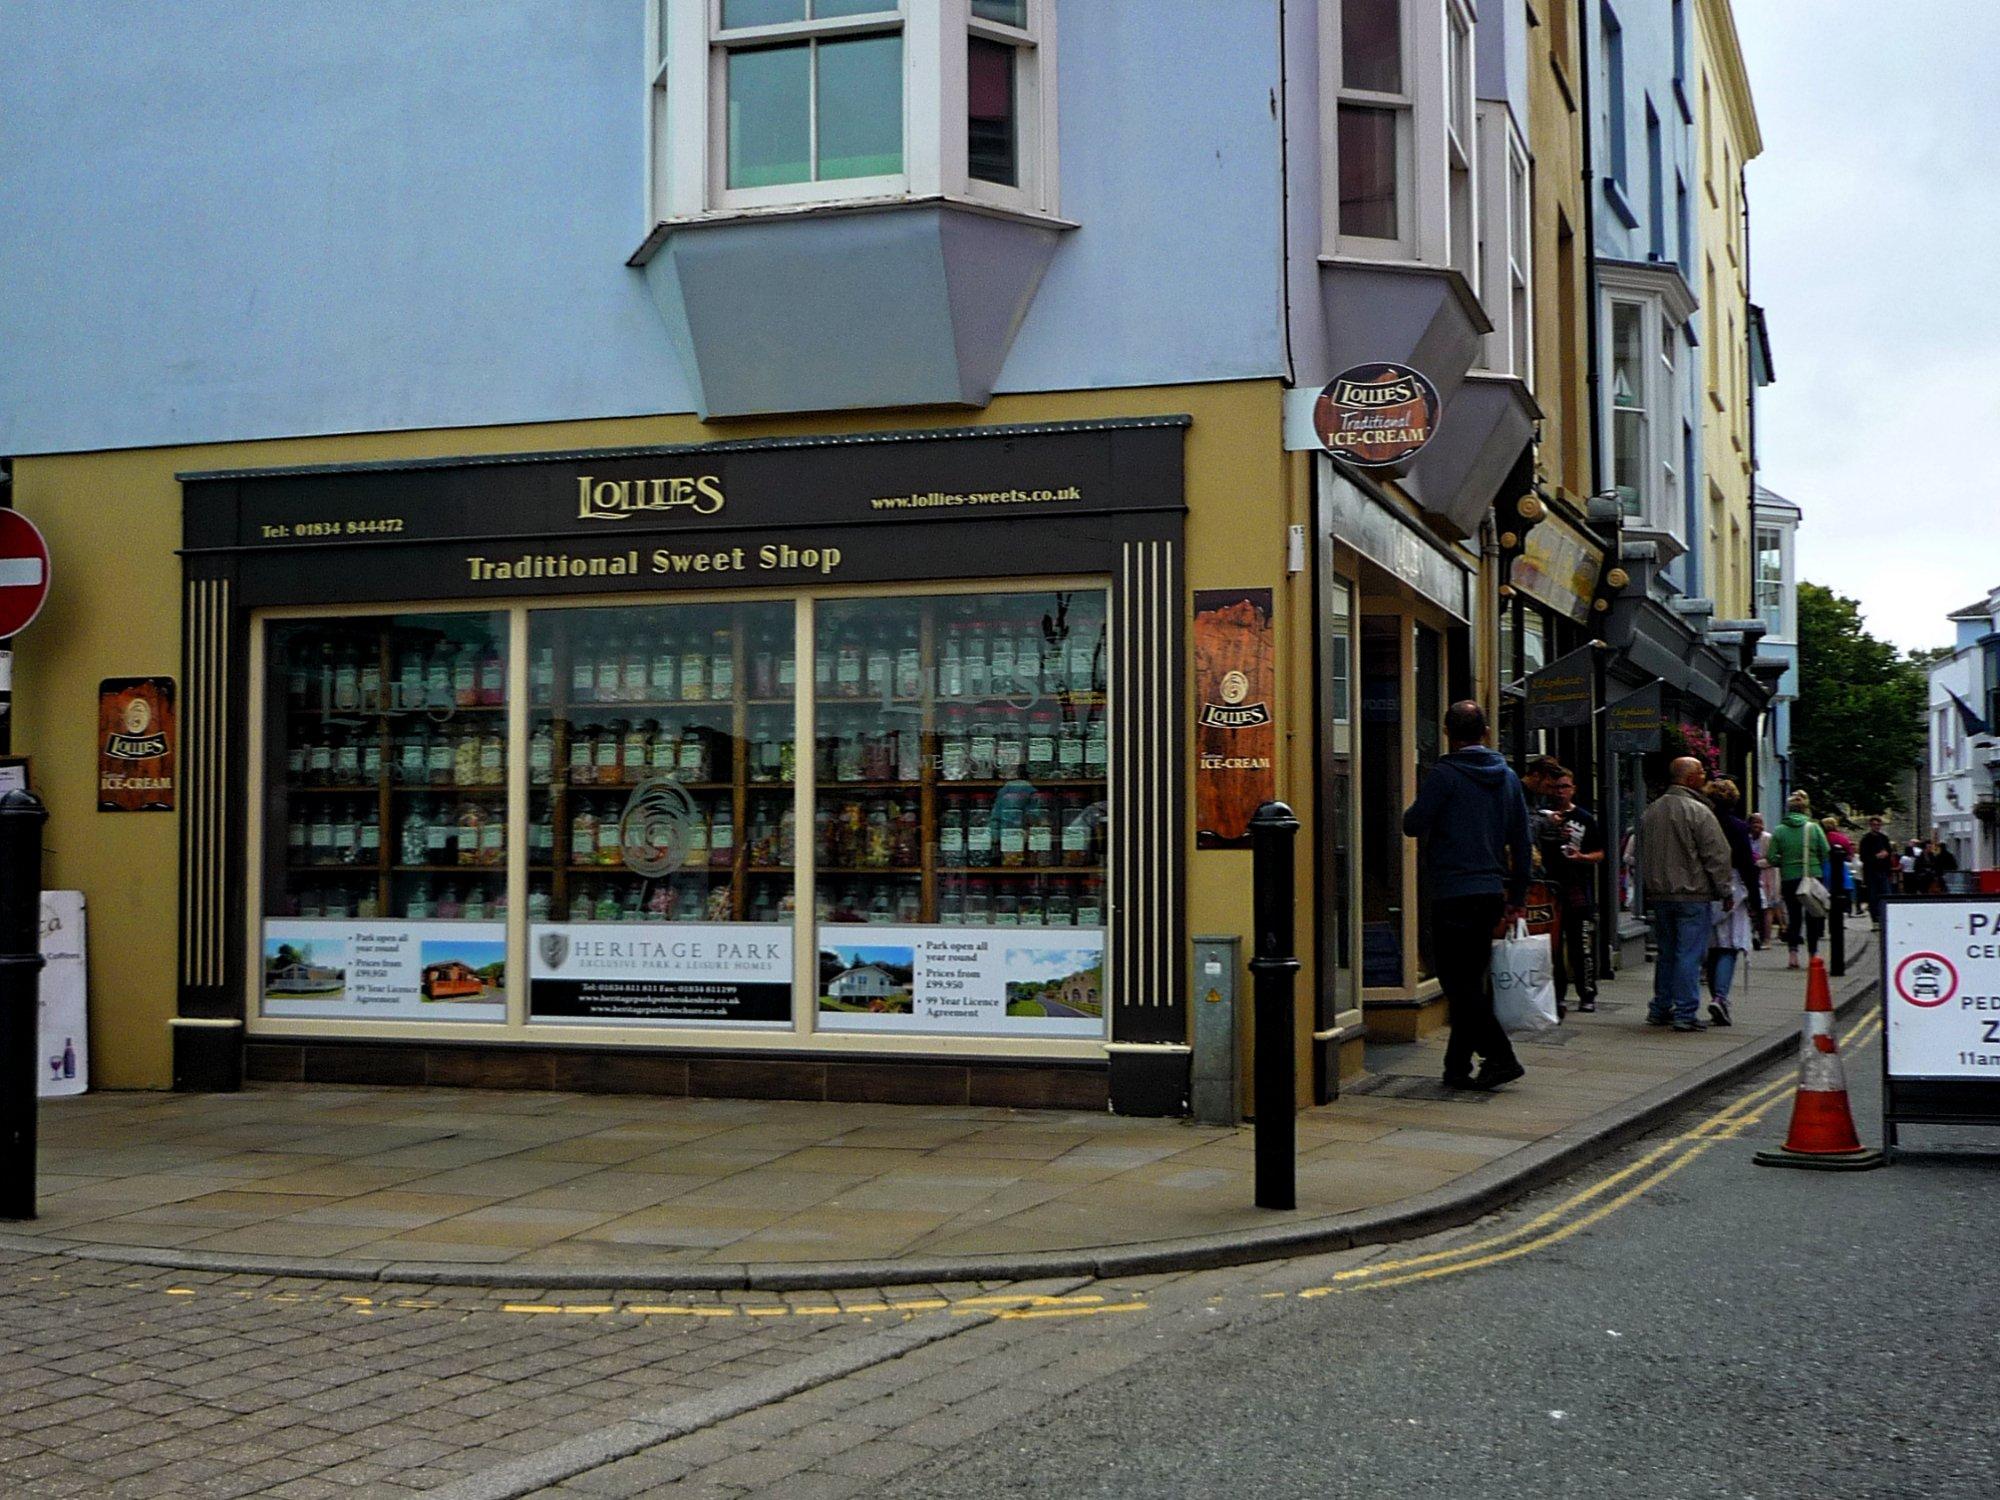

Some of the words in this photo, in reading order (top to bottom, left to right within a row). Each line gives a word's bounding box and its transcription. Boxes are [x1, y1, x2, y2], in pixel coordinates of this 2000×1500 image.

[1340, 384, 1411, 406] LOLLIES
[1340, 410, 1412, 430] Traditional
[1328, 428, 1425, 446] ICE-CREAM
[577, 475, 725, 520] LOLLIES
[870, 486, 1082, 510] www.lollies-sweets.co.uk
[261, 525, 290, 538] Tel:
[295, 522, 341, 536] 01834
[346, 519, 404, 534] 844472
[466, 550, 638, 580] Traditional
[652, 548, 746, 574] Sweet
[759, 544, 842, 574] Shop
[1206, 706, 1265, 728] LOLLIES
[110, 737, 165, 758] LOLLIES
[1200, 758, 1271, 769] ICE-CREAM
[101, 777, 172, 790] ICE-CREAM
[575, 941, 702, 958] HERITAGE
[717, 943, 781, 960] PARK
[926, 941, 948, 950] Park
[950, 943, 974, 952] open
[976, 941, 988, 950] all
[1967, 944, 2000, 958] CE
[580, 959, 636, 968] EXCLUSIVE
[642, 960, 669, 968] PARK
[687, 961, 729, 970] LEISURE
[735, 961, 772, 970] HOMES
[926, 955, 946, 963] year
[948, 953, 977, 961] round
[926, 969, 955, 978] Prices
[957, 969, 980, 978] from
[940, 997, 960, 1005] Year
[963, 997, 999, 1006] Licence
[927, 1008, 979, 1018] Agreement
[1982, 1020, 2000, 1043] Z
